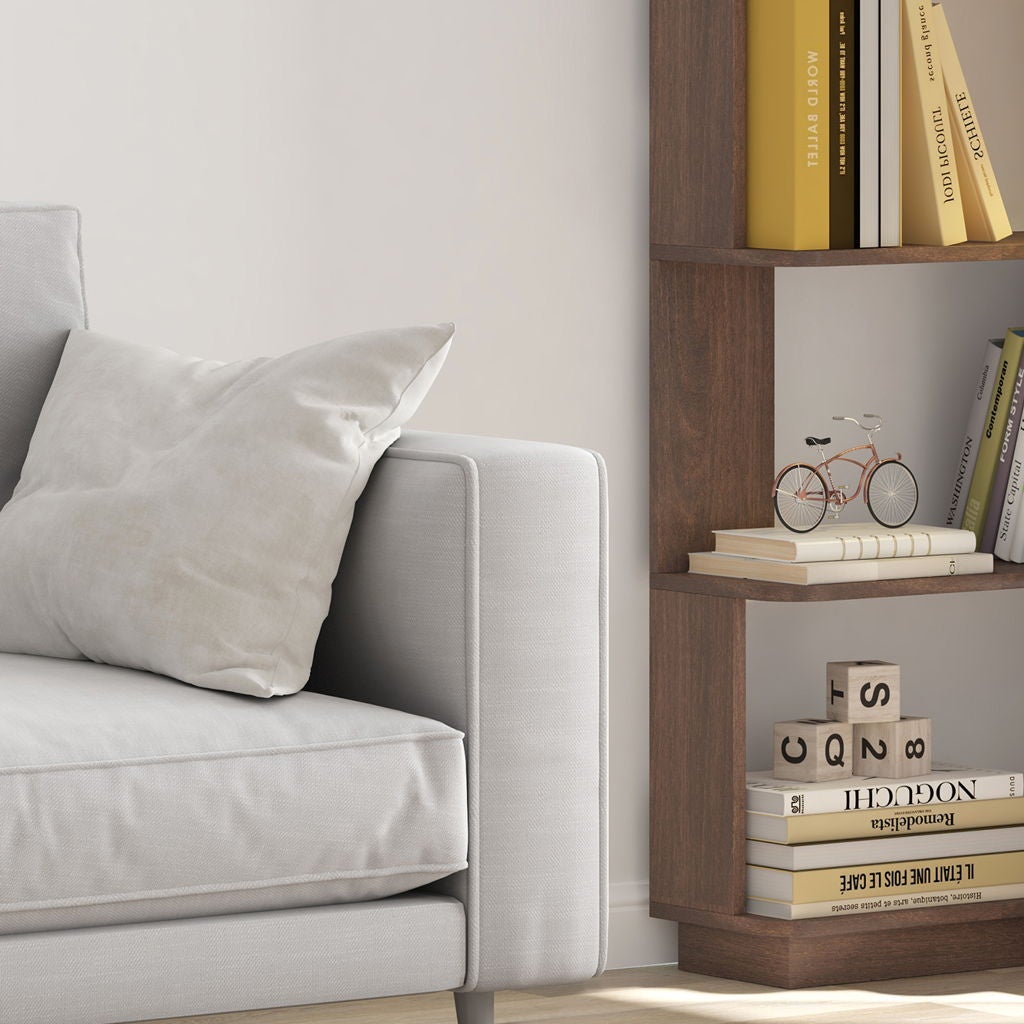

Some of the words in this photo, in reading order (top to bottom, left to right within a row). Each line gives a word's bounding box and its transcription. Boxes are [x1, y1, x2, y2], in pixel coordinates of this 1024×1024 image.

[986, 361, 1008, 438] Contemporan
[1000, 420, 1013, 463] FORM
[1010, 368, 1024, 416] STYLE
[946, 436, 973, 524] WASHINGTON
[977, 365, 989, 400] Columbia
[1000, 509, 1011, 541] State
[1007, 460, 1021, 505] Capital
[831, 680, 844, 705] T
[860, 682, 890, 708] S
[781, 736, 807, 764] C
[825, 734, 844, 767] Q
[862, 737, 887, 760] 2
[905, 738, 925, 759] 8
[844, 779, 976, 810] NOGUCHI
[871, 812, 954, 832] Remodelista
[870, 872, 881, 888] LE
[885, 870, 907, 887] FOIS
[910, 867, 930, 885] UNE
[933, 865, 962, 884] ÉTAIT
[965, 864, 974, 879] IL
[840, 873, 866, 895] CAFÉ
[861, 901, 882, 910] petits
[893, 898, 908, 906] arts
[911, 894, 948, 903] botanique,
[951, 892, 981, 900] Histoire,
[832, 903, 859, 911] secrets
